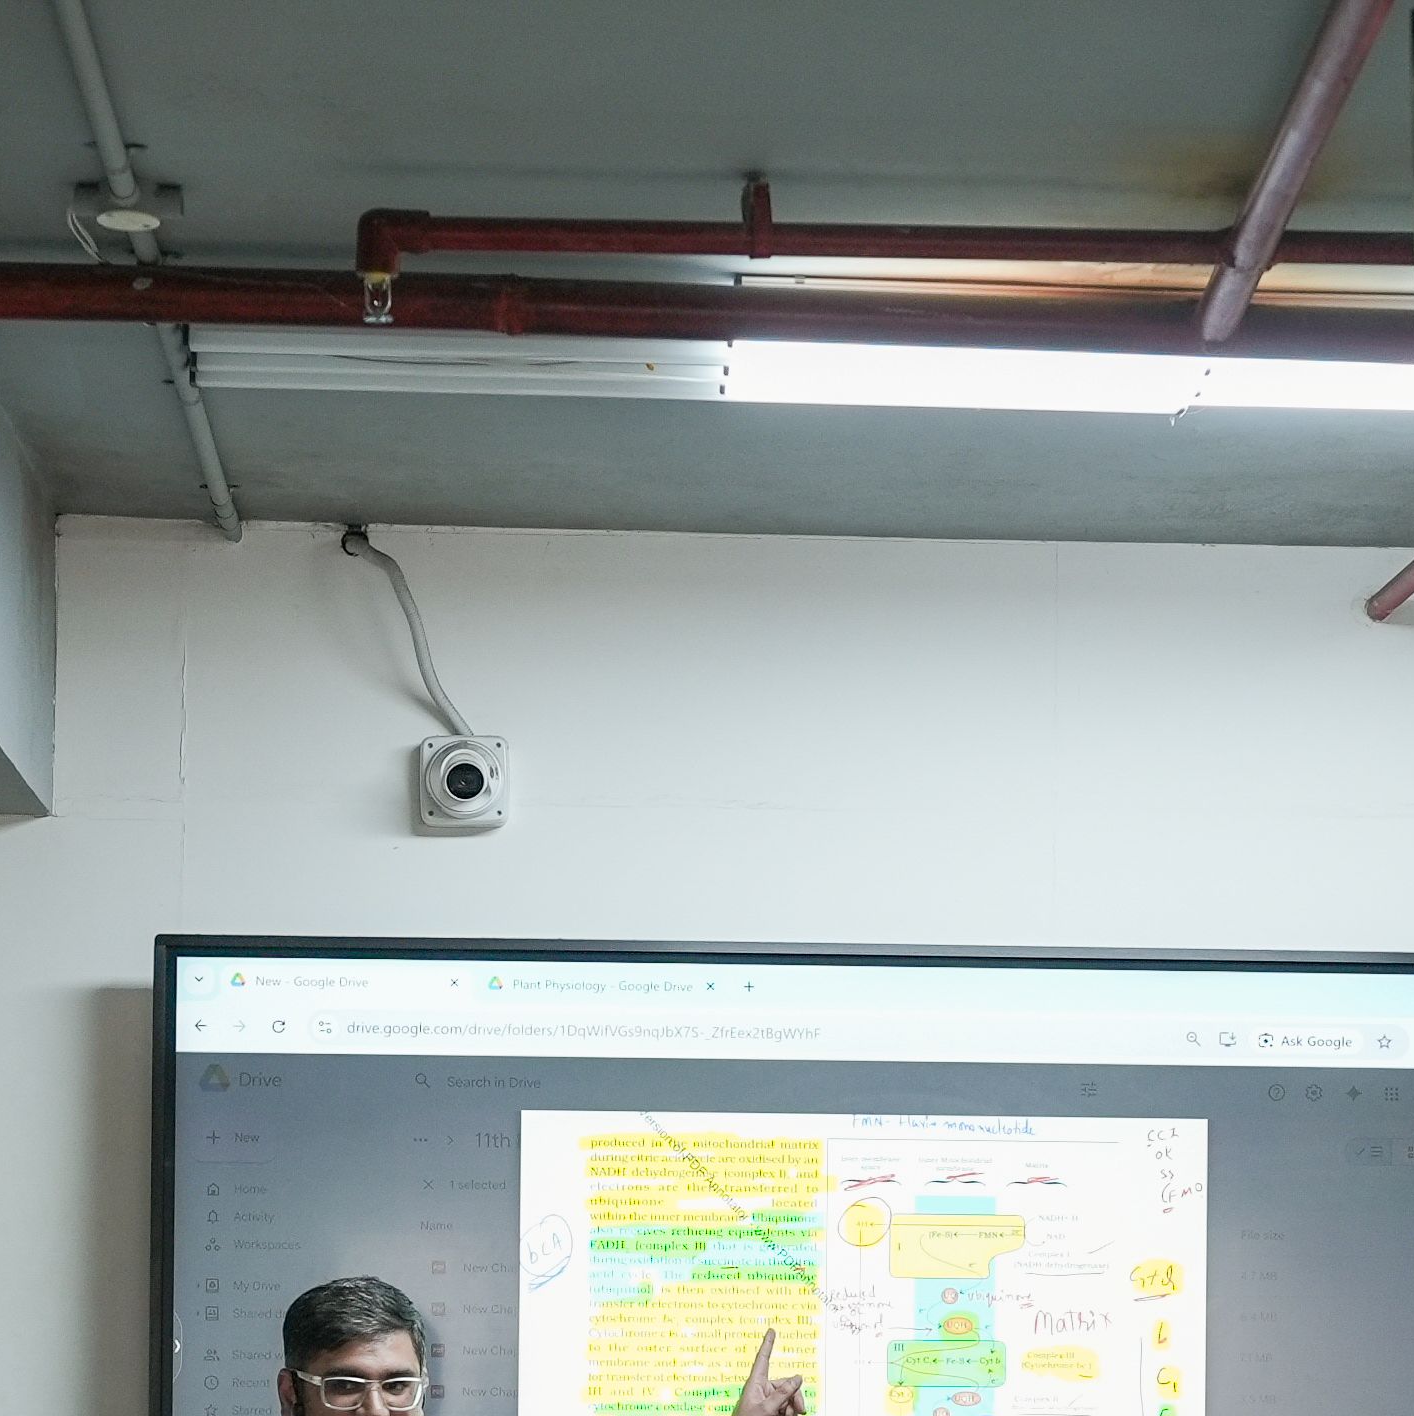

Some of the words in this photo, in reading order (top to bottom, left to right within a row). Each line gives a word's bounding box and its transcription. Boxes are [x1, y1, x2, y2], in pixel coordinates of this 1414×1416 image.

[255, 975, 281, 986] New
[293, 975, 335, 989] Google
[339, 976, 368, 988] Drive
[513, 978, 541, 990] Plant
[545, 978, 607, 994] Physiology
[618, 980, 661, 994] Google
[663, 980, 693, 992] Drive
[1281, 1035, 1303, 1046] Ask
[1307, 1035, 1352, 1050] Google
[238, 1071, 283, 1089] Drive
[446, 1075, 491, 1088] Search
[494, 1076, 505, 1088] in
[509, 1076, 541, 1089] Drive
[234, 1132, 260, 1143] New
